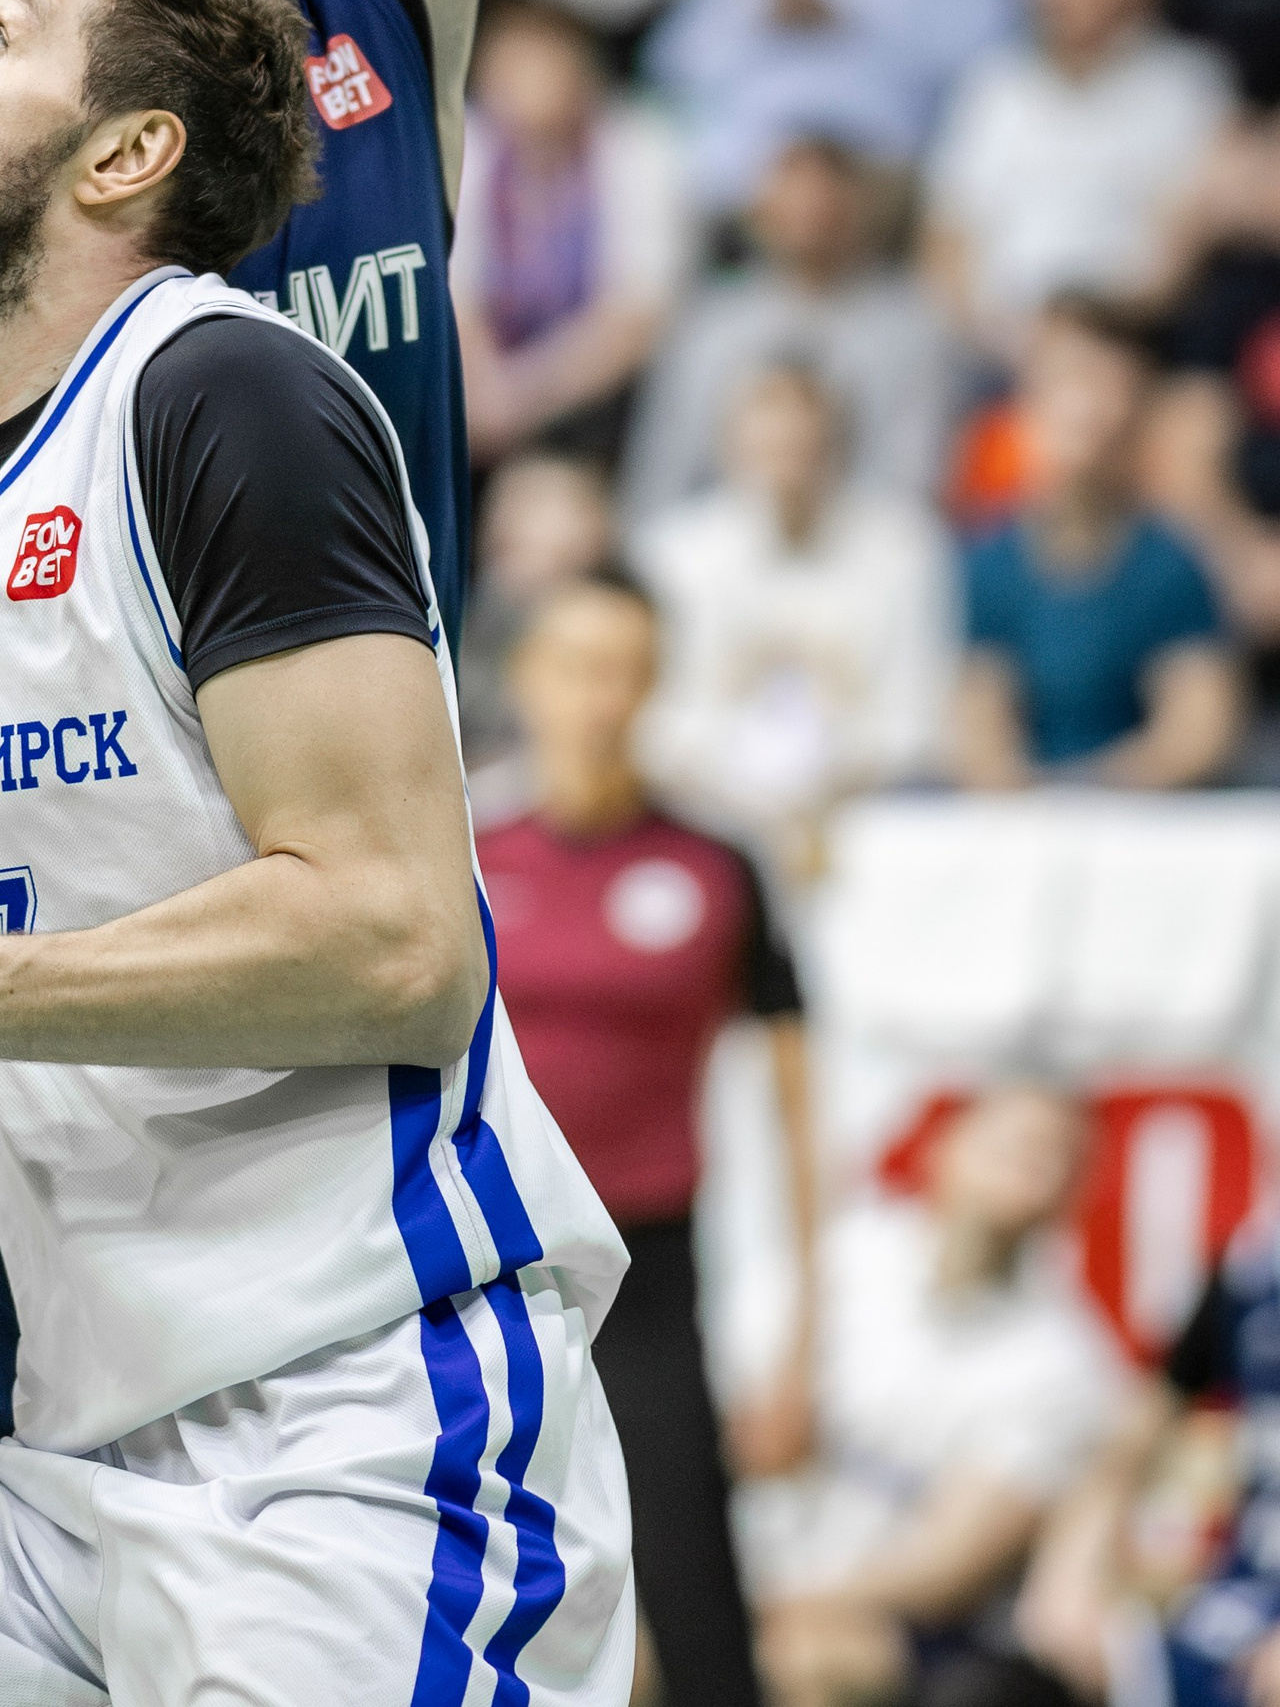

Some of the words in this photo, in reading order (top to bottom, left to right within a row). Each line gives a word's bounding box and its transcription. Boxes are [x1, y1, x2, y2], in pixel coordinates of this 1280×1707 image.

[322, 70, 373, 121] BET
[20, 515, 75, 556] FON
[11, 548, 72, 589] BET
